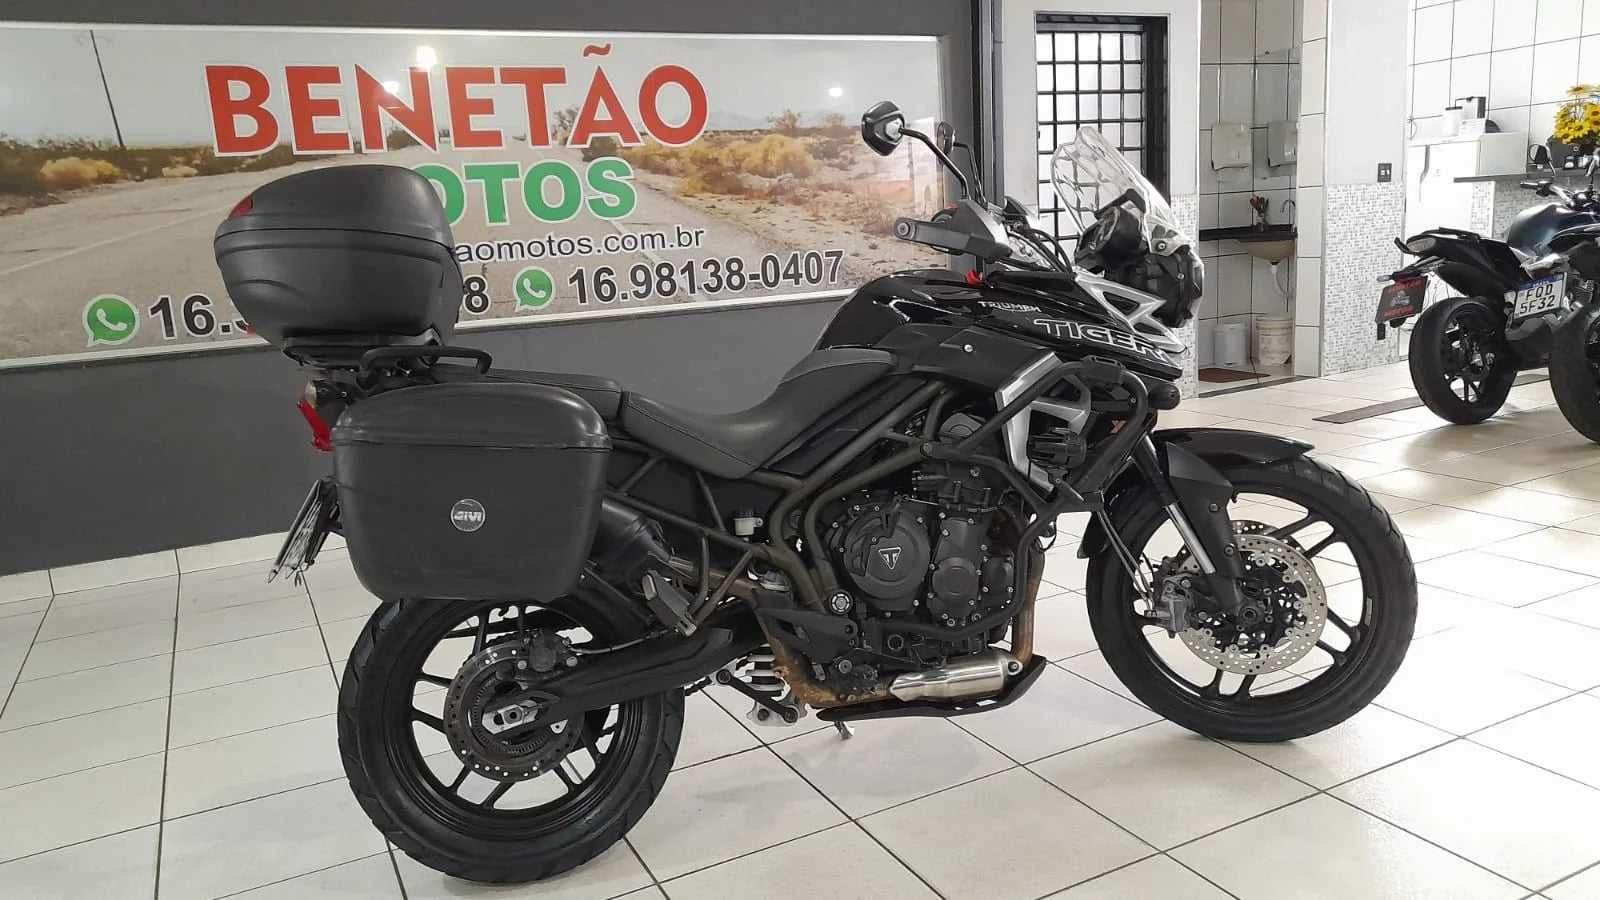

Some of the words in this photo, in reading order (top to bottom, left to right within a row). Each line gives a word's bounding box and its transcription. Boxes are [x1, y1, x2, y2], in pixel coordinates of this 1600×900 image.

[205, 43, 708, 155] BENETÃO
[456, 226, 705, 263] aomotos.com.br
[568, 250, 845, 304] 16.98138-0407
[150, 295, 248, 338] 16.
[977, 301, 1042, 313] TRIUMPH
[1520, 295, 1555, 314] 5F32
[1033, 318, 1170, 363] TIGER
